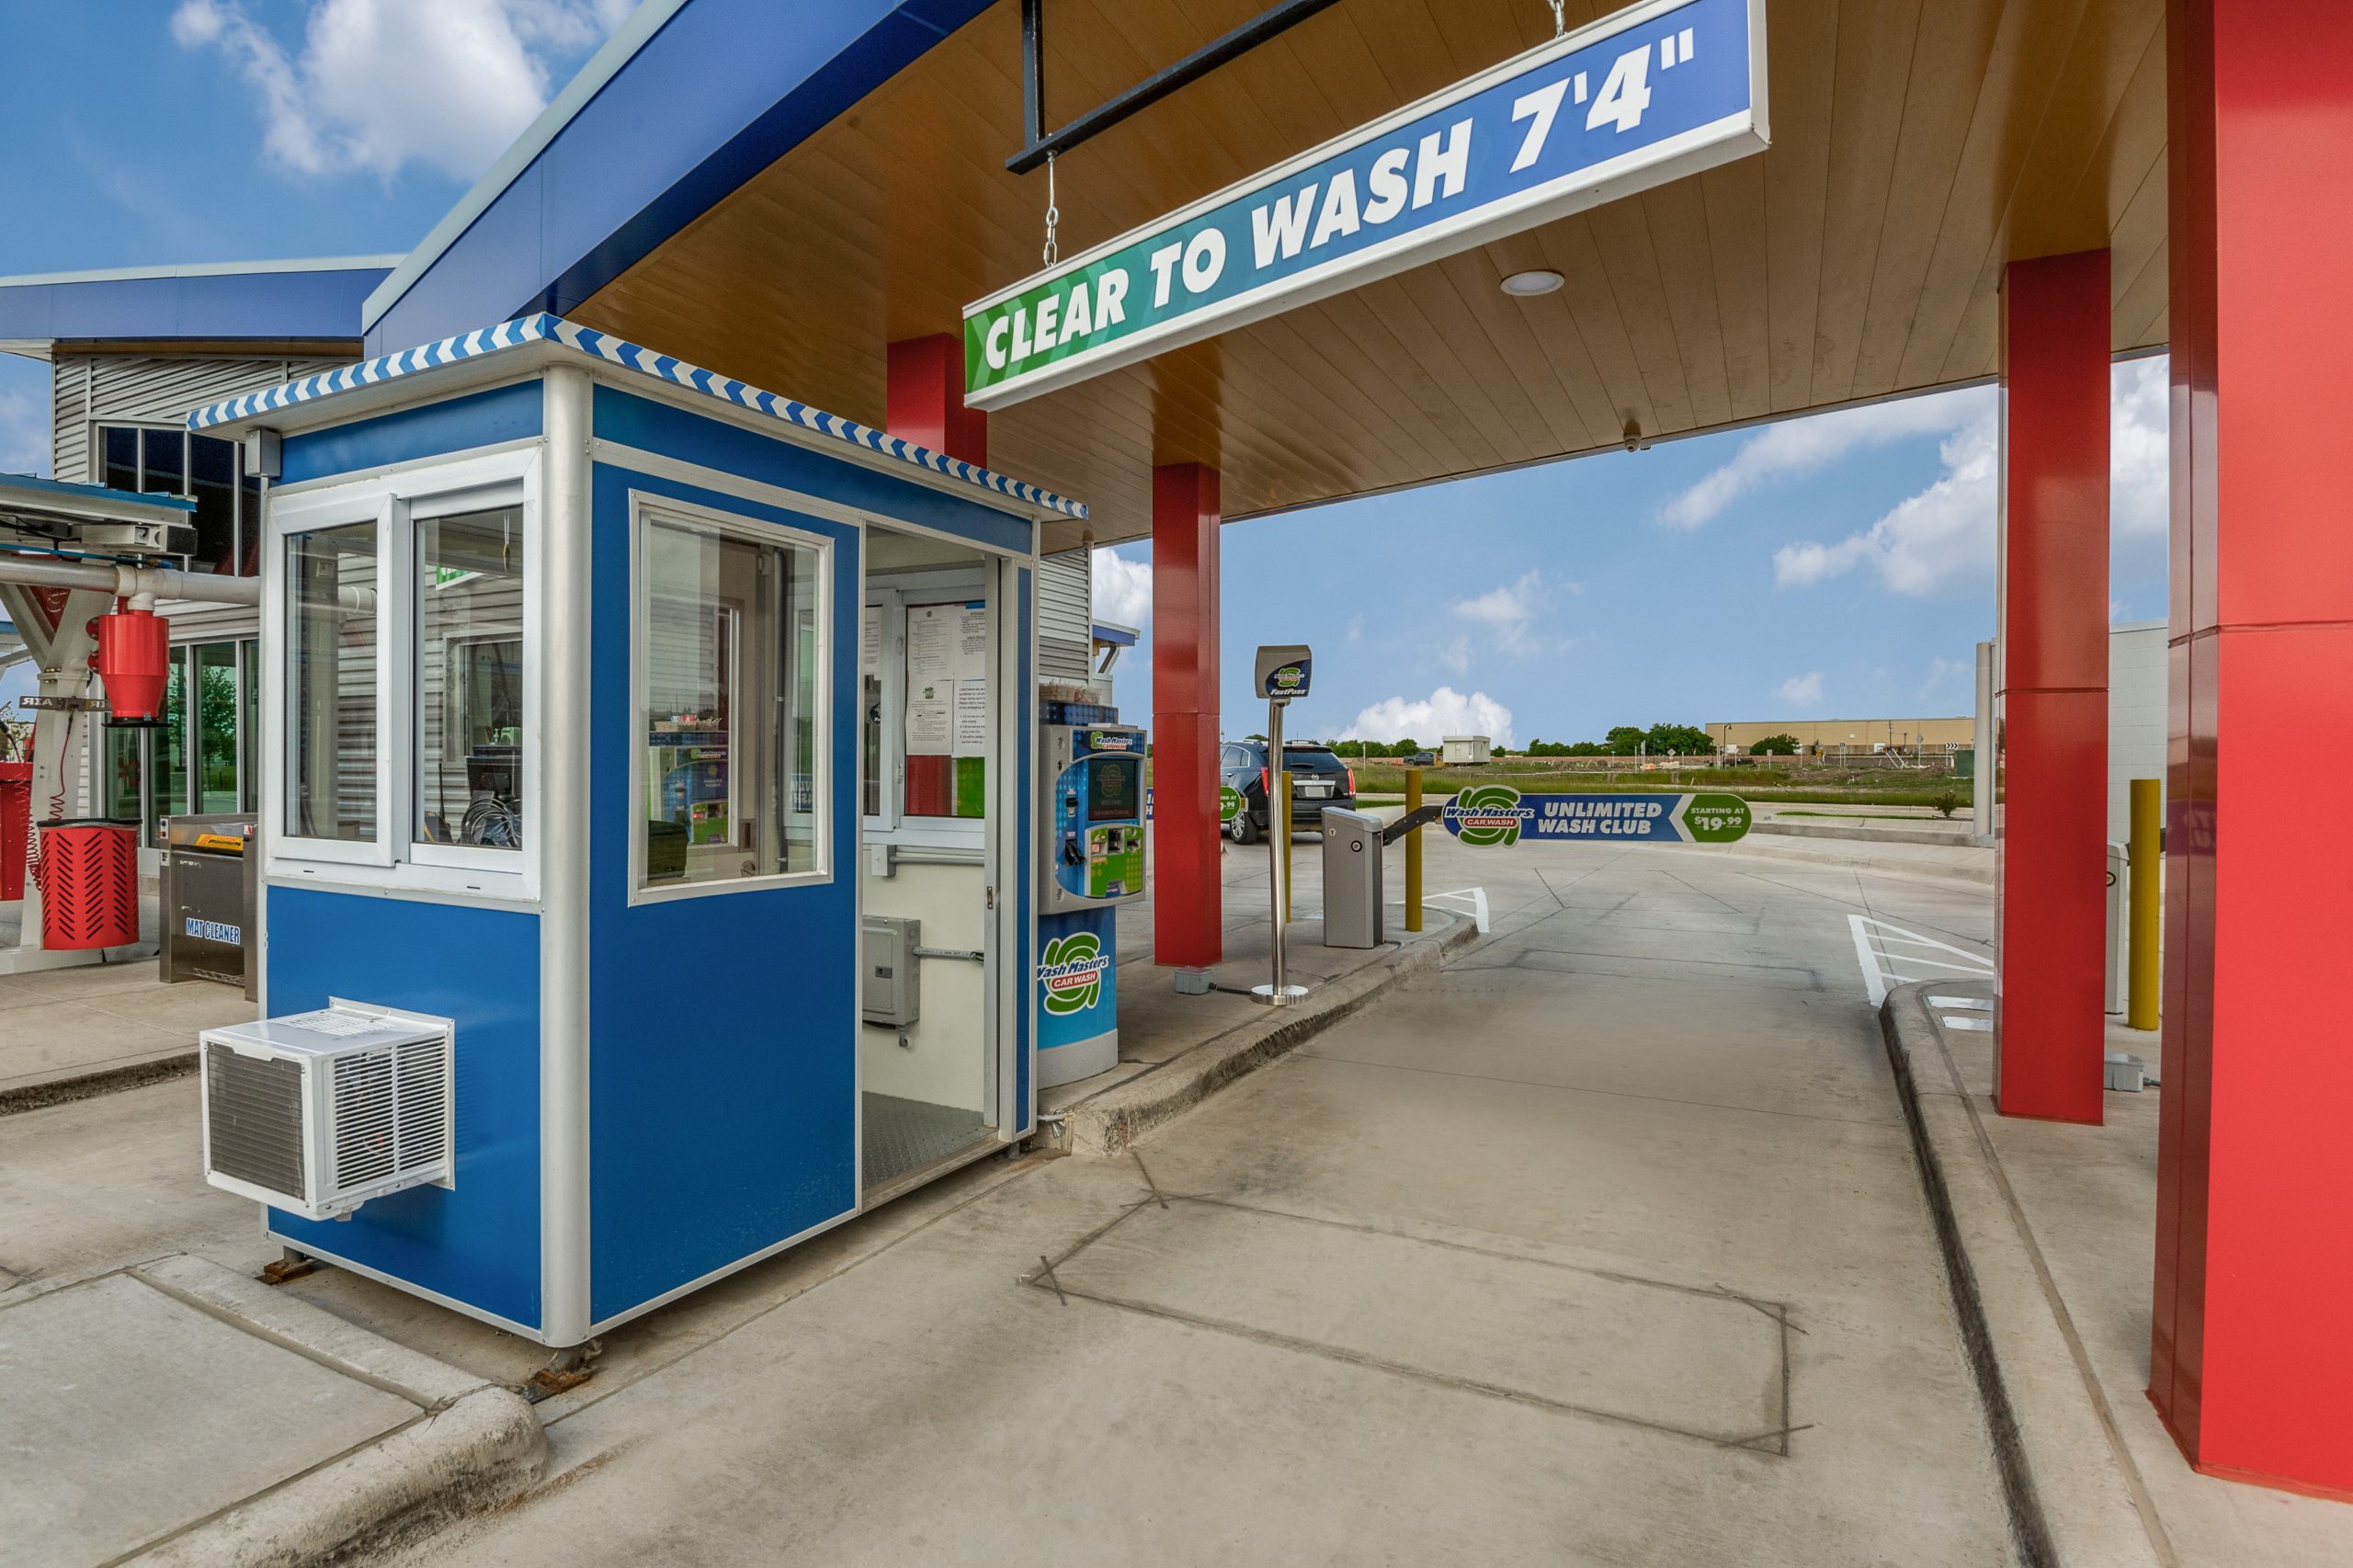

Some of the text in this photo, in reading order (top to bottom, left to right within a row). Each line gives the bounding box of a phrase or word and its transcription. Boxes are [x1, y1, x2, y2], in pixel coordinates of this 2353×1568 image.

[984, 27, 1695, 369] CLEAR TO WASH 7'4"
[1446, 808, 1532, 817] Wash Masters
[1544, 802, 1663, 817] UNLIMITED
[1538, 819, 1652, 834] WASH CLUB
[1694, 816, 1742, 831] $19.99
[187, 918, 240, 945] MAT CLEANER
[1068, 956, 1108, 973] Masters
[1054, 972, 1096, 987] CAR WASH
